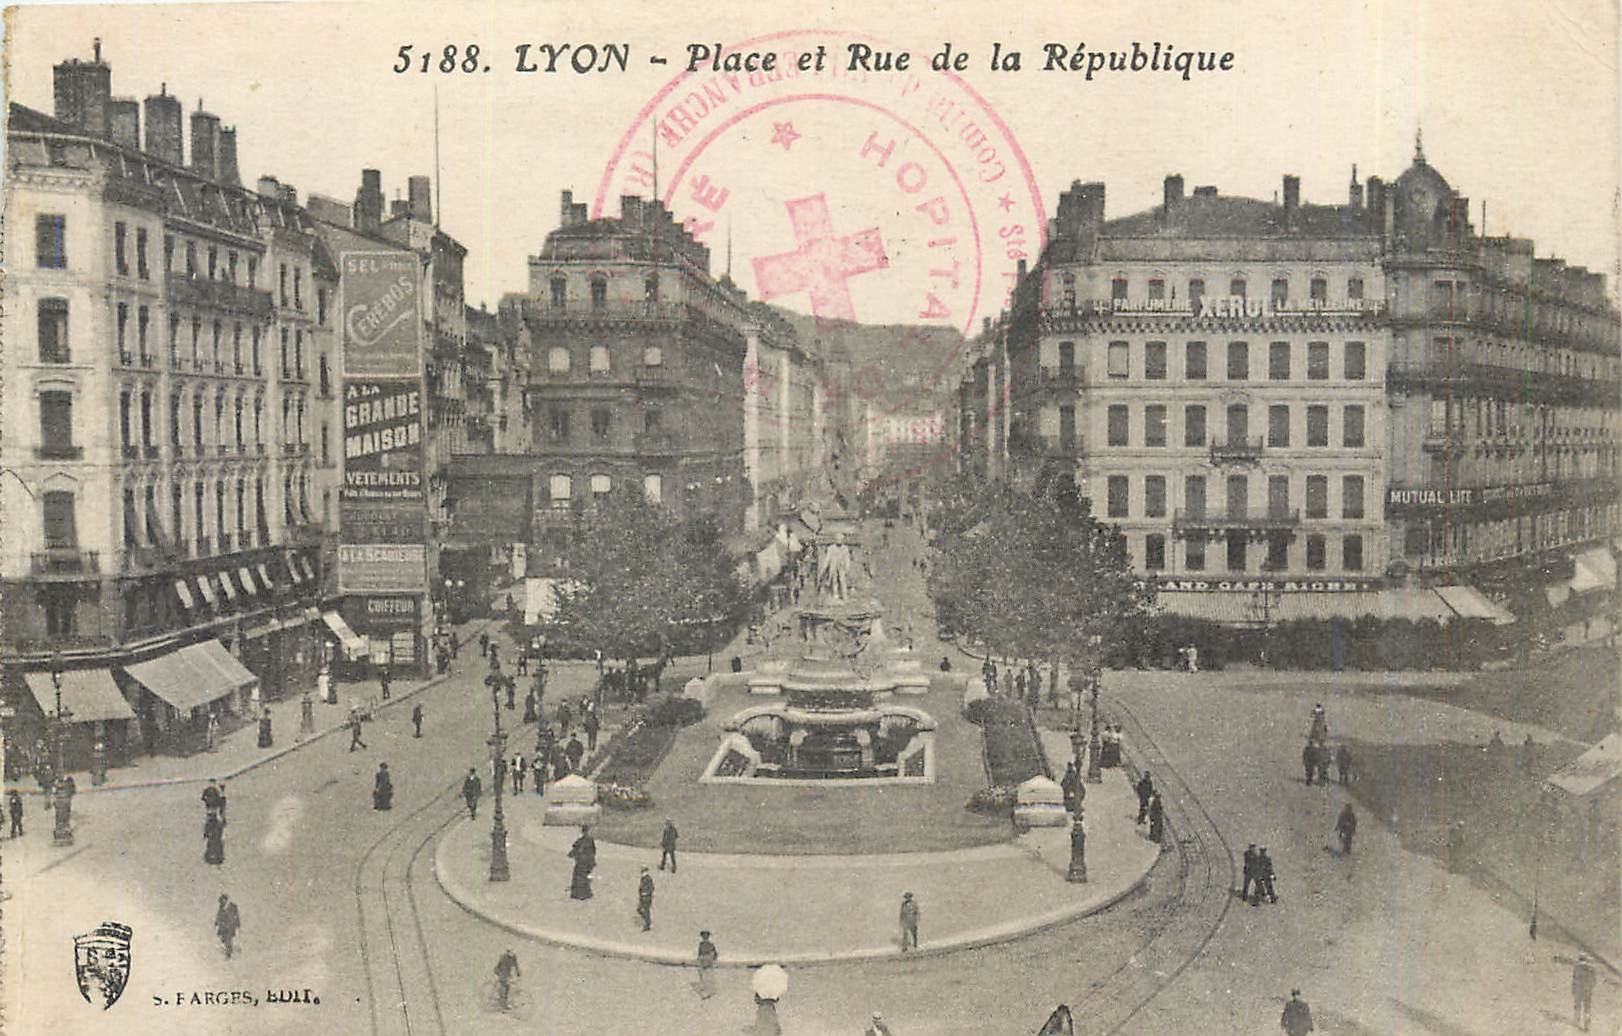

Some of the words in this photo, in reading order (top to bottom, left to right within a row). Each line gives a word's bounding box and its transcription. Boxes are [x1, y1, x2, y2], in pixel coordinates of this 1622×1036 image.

[347, 385, 359, 400] A
[346, 391, 419, 429] GRANDE
[346, 423, 419, 459] MAISON
[1390, 489, 1445, 504] MUTUAL
